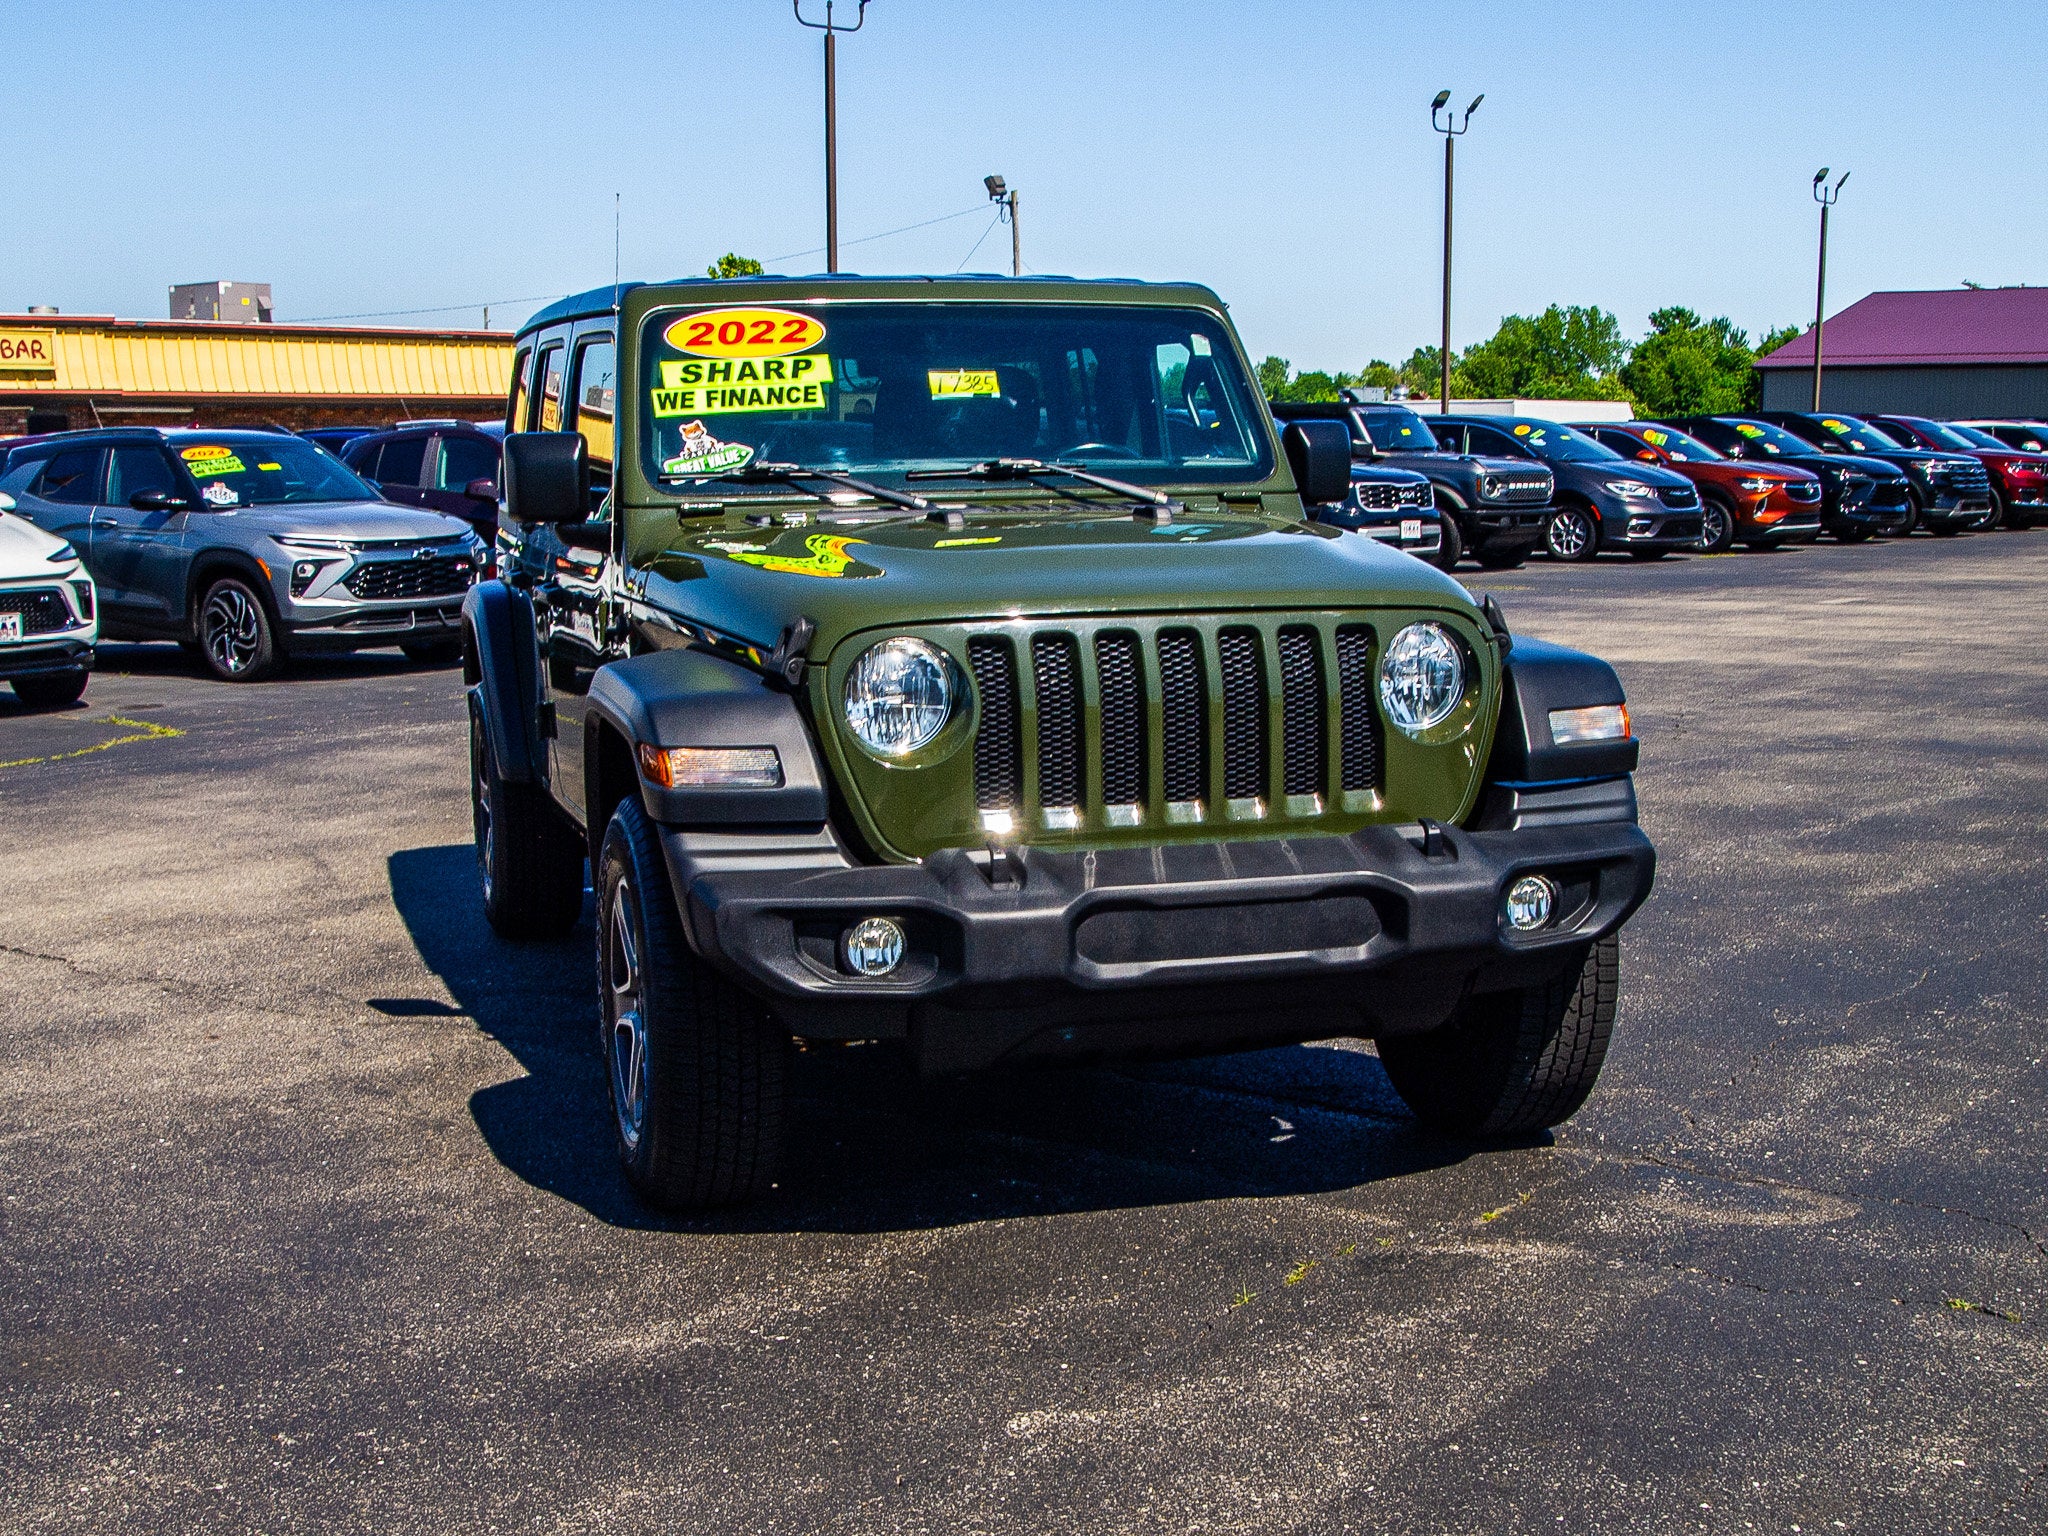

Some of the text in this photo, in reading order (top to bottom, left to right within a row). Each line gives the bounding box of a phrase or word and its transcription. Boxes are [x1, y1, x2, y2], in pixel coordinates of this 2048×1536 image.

[685, 319, 808, 346] 2022
[0, 338, 46, 359] BAR
[680, 359, 812, 384] SHARP
[656, 385, 817, 411] WE FINANCE
[673, 449, 741, 473] GREAT VALUE
[1508, 482, 1547, 490] BRONCO
